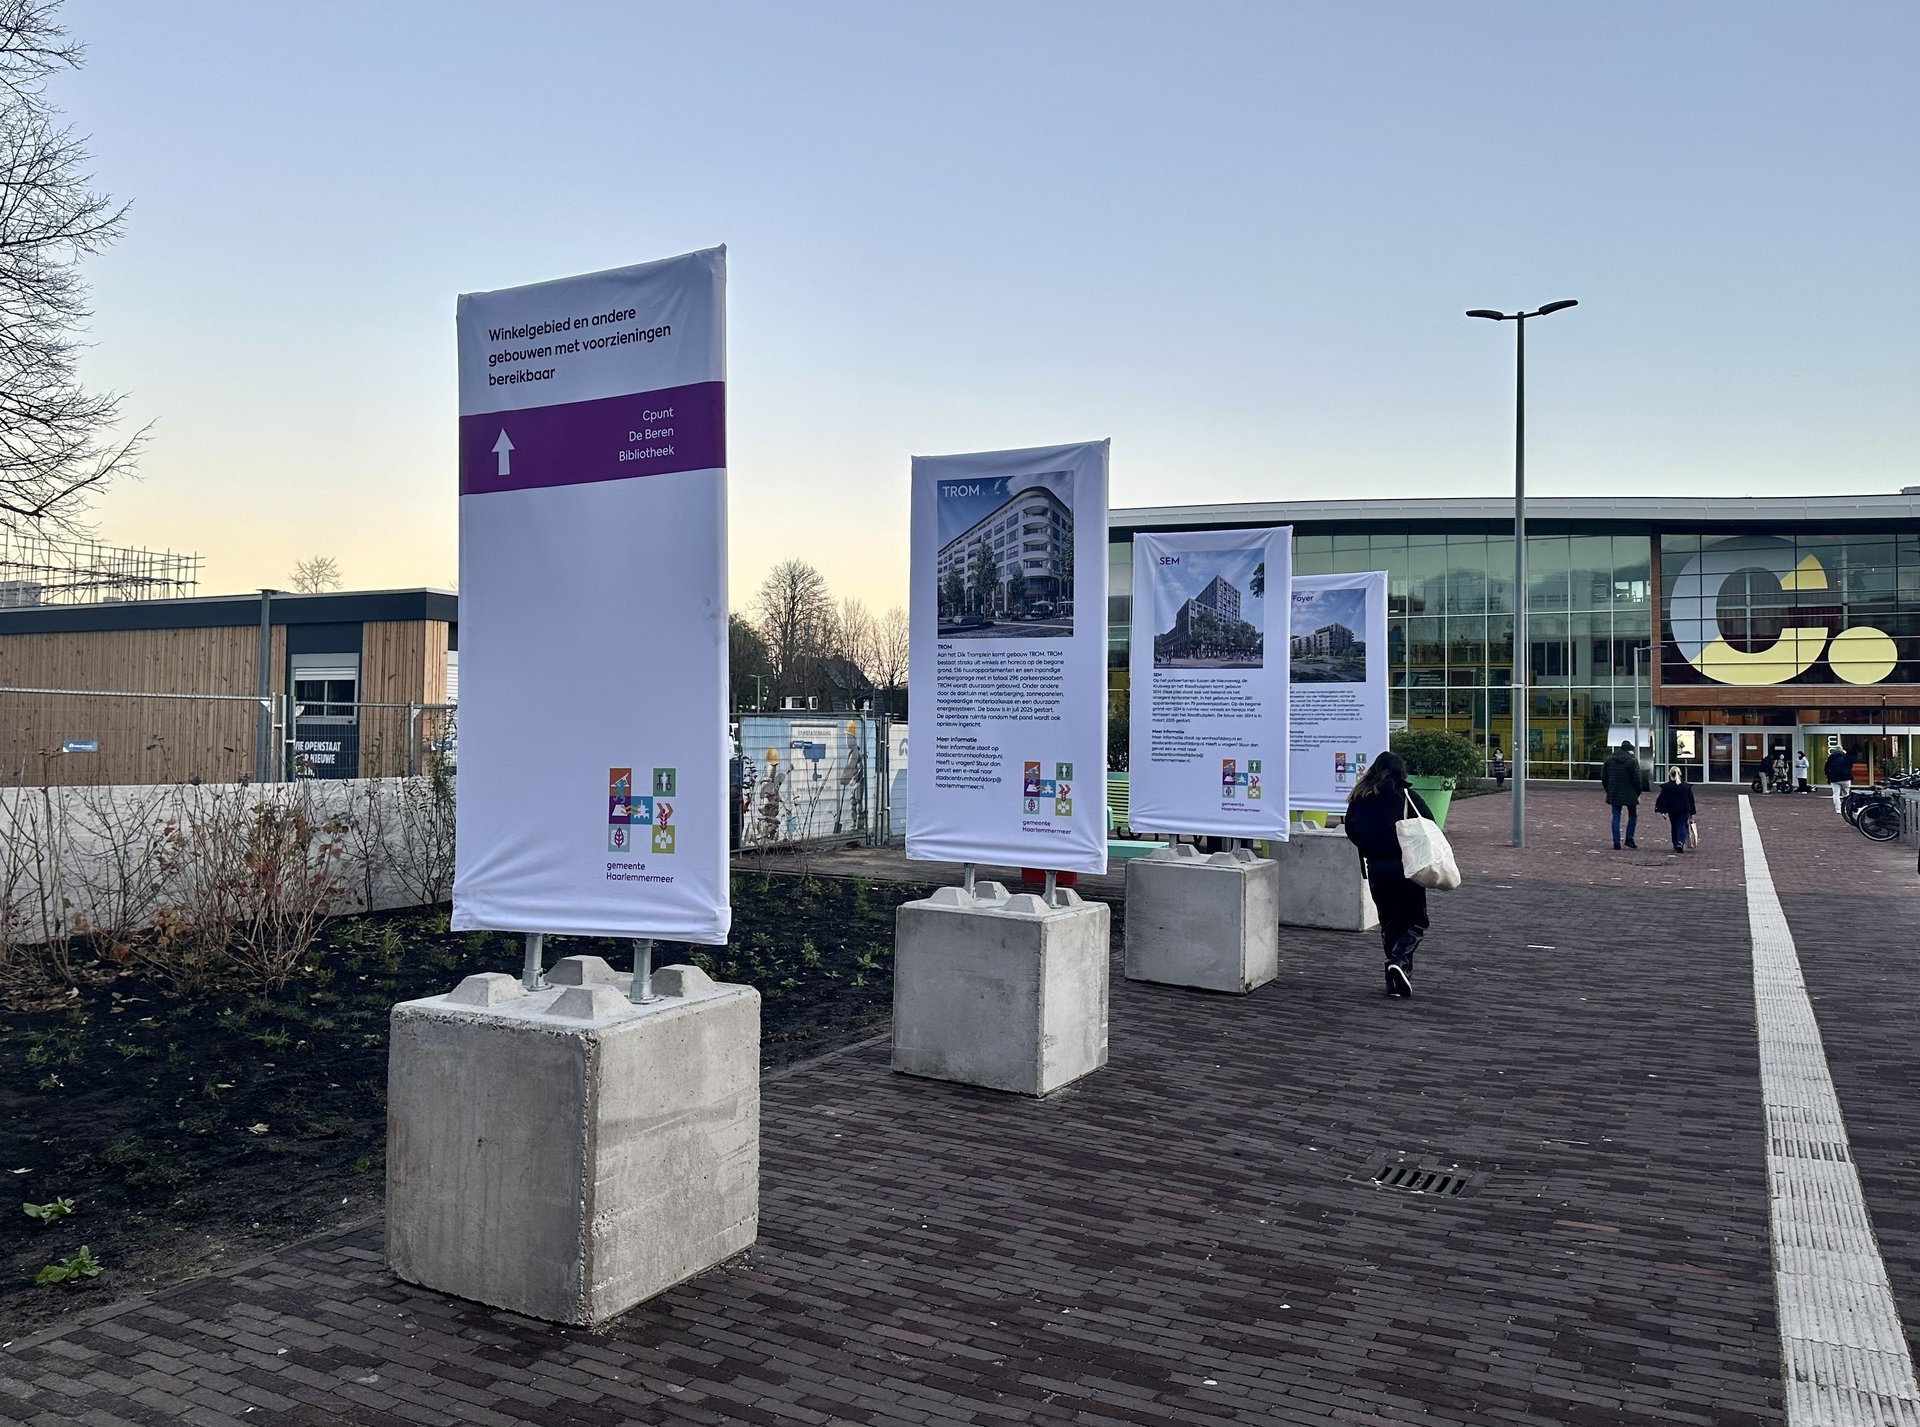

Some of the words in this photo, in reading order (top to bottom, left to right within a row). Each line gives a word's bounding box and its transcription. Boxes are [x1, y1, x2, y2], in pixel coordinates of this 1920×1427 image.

[489, 318, 570, 342] Winkelgebied
[574, 318, 588, 328] en
[592, 307, 636, 326] andere
[488, 346, 552, 366] gebouwen
[555, 340, 580, 355] met
[583, 324, 671, 350] voorzieningen
[489, 367, 555, 386] bereikbaar
[642, 407, 674, 422] Cpunt
[629, 431, 642, 442] De
[645, 427, 674, 440] Beren
[619, 445, 674, 461] Bibliotheek
[942, 484, 980, 498] TROM
[1160, 556, 1180, 565] SEM
[305, 741, 341, 751] OPENSTAAT
[936, 775, 1001, 784] stadscentrumhoofddorp@
[607, 862, 645, 871] gemeente
[607, 872, 674, 883] Haarlemmermeer
